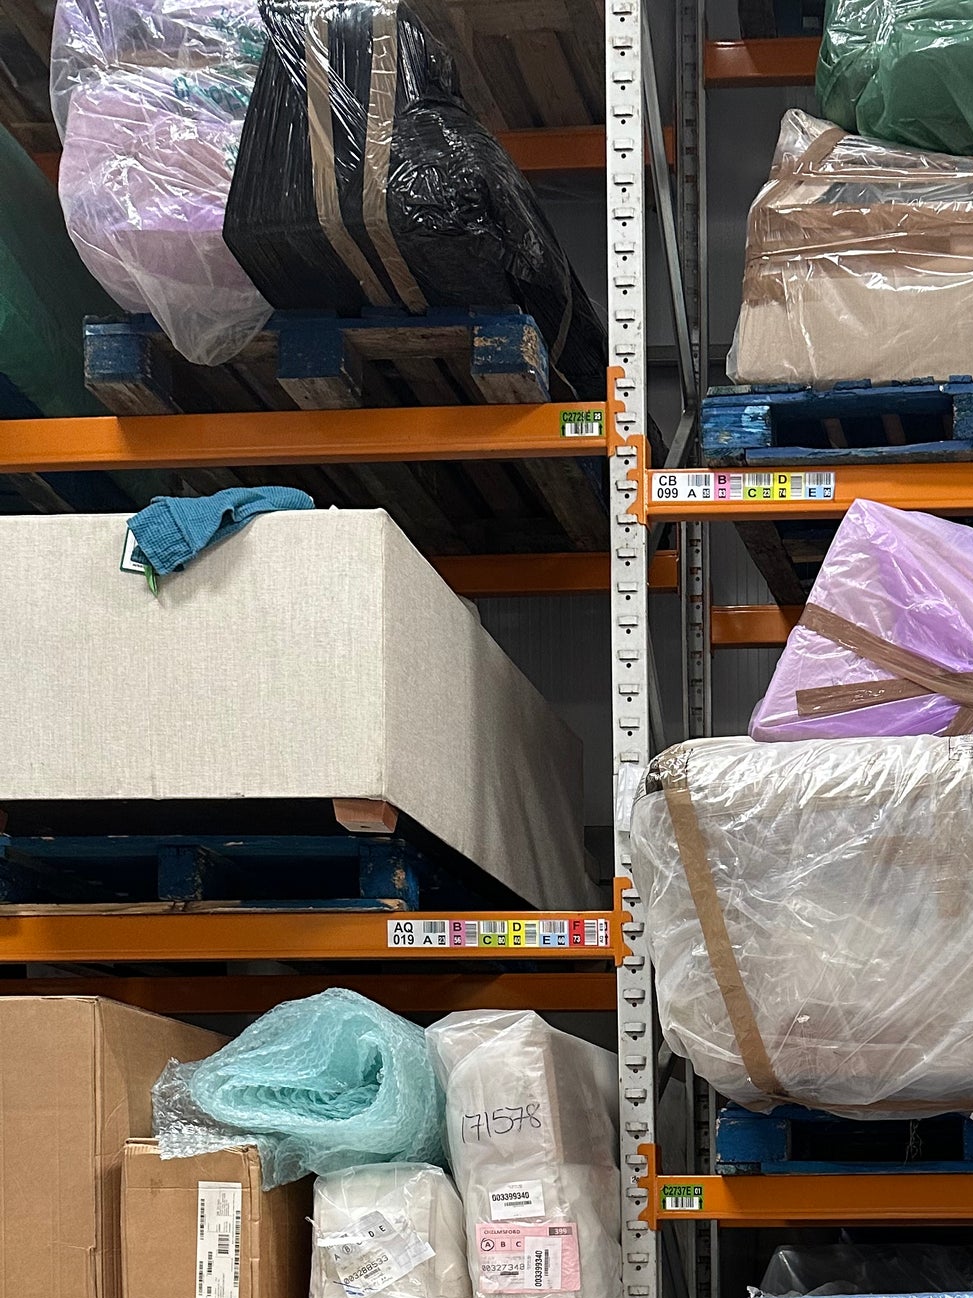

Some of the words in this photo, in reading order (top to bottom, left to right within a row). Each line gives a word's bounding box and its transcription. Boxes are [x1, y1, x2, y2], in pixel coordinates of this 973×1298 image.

[659, 475, 677, 486] CB
[717, 475, 727, 485] B
[778, 475, 787, 484] D
[657, 488, 679, 499] 099
[687, 488, 697, 498] A
[748, 488, 757, 498] C
[808, 488, 816, 497] E
[394, 922, 414, 934] AQ
[453, 922, 462, 932] B
[513, 922, 521, 932] D
[573, 921, 581, 931] F
[393, 934, 414, 945] 019
[423, 935, 432, 945] A
[483, 935, 492, 945] C
[543, 935, 550, 944] E
[462, 1103, 541, 1143] 171578
[663, 1186, 691, 1196] C2737E
[492, 1191, 530, 1202] 003399340
[535, 1250, 543, 1288] 003399340
